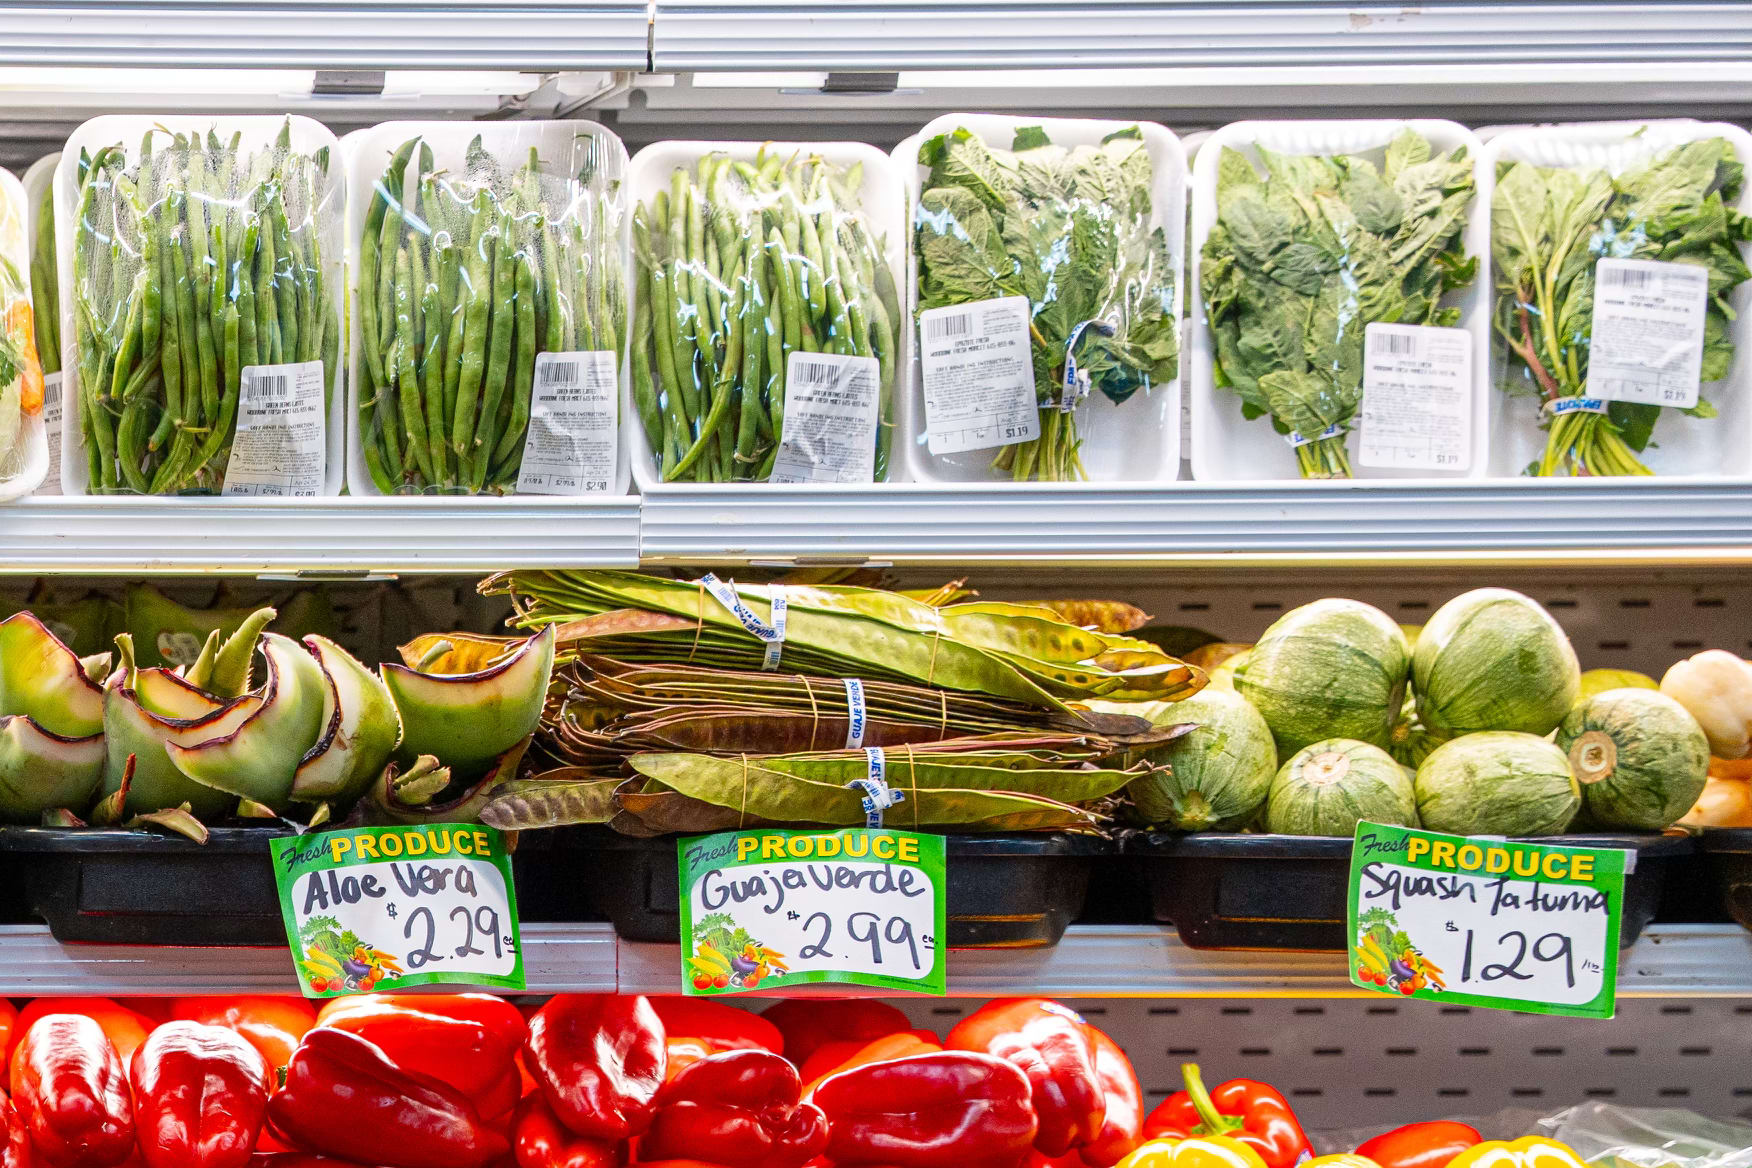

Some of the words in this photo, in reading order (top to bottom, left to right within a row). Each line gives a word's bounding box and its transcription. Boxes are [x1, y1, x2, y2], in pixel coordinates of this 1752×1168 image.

[1006, 426, 1028, 438] $1.19
[852, 708, 862, 739] GUAJE
[280, 835, 332, 873] Fresh
[329, 830, 492, 864] PRODUCE
[685, 834, 739, 871] Fresh
[736, 834, 921, 863] PRODUCE
[1360, 833, 1411, 856] Fresh
[1407, 837, 1595, 881] PRODUCE
[303, 870, 387, 915] Aloe
[390, 862, 478, 898] Vera
[807, 863, 926, 898] Verde
[1360, 861, 1477, 910] Squash
[1484, 875, 1611, 916] Tatuma
